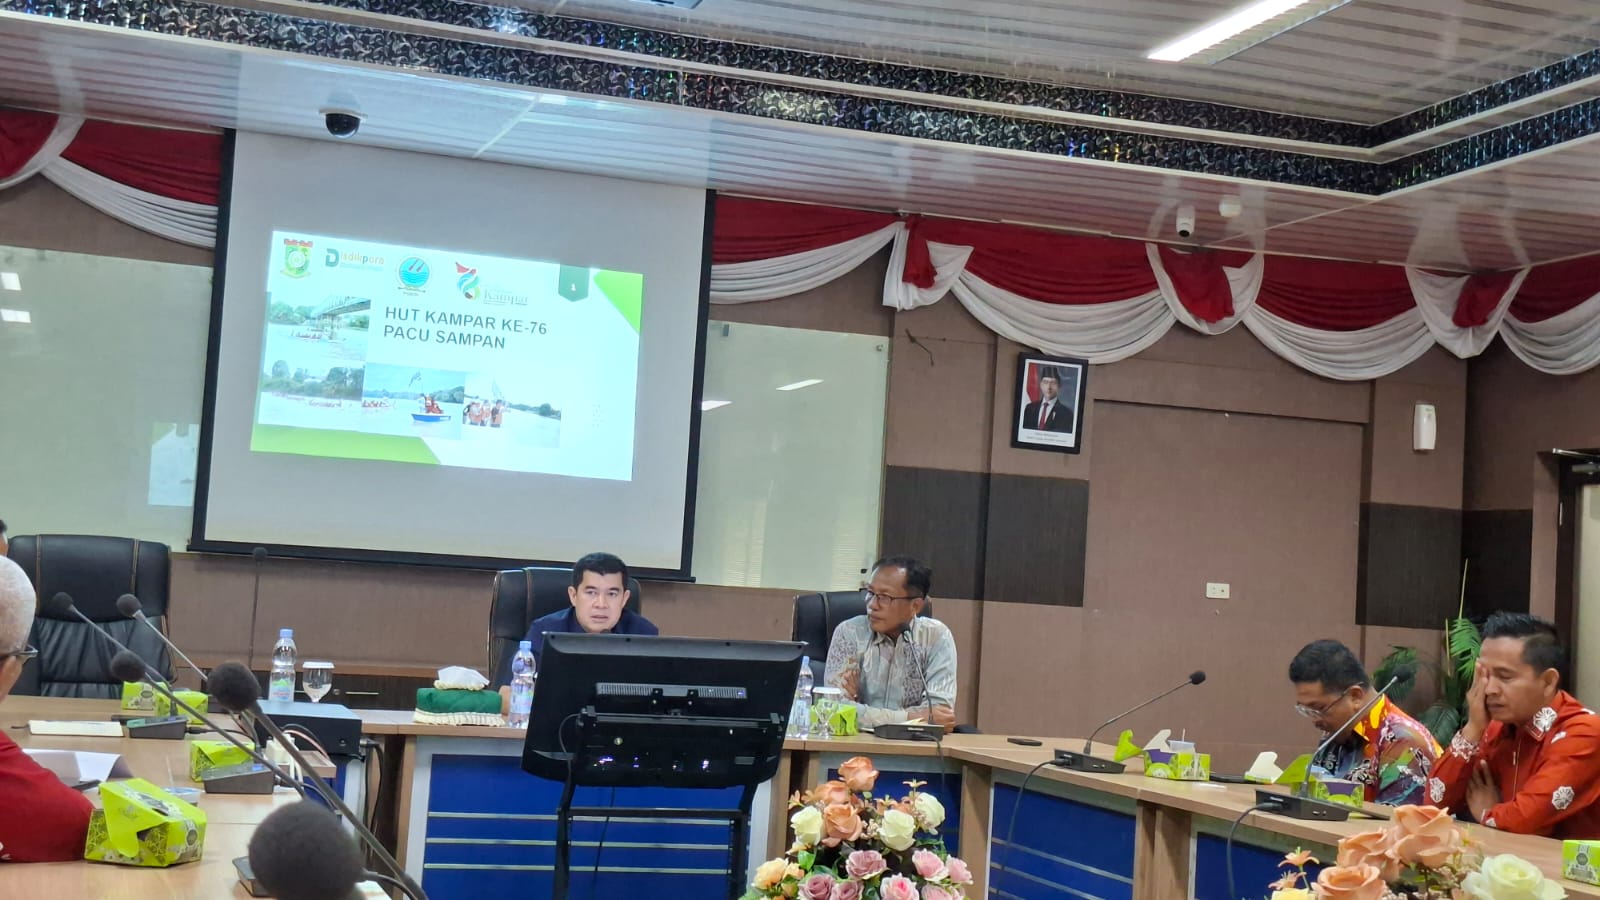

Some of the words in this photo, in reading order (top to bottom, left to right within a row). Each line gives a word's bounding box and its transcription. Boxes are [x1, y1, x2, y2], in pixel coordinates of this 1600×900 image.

[385, 306, 420, 322] HUT
[425, 310, 496, 330] KAMPAR
[502, 318, 547, 335] KE-76
[384, 324, 430, 342] PACU
[435, 330, 506, 349] SAMPAN
